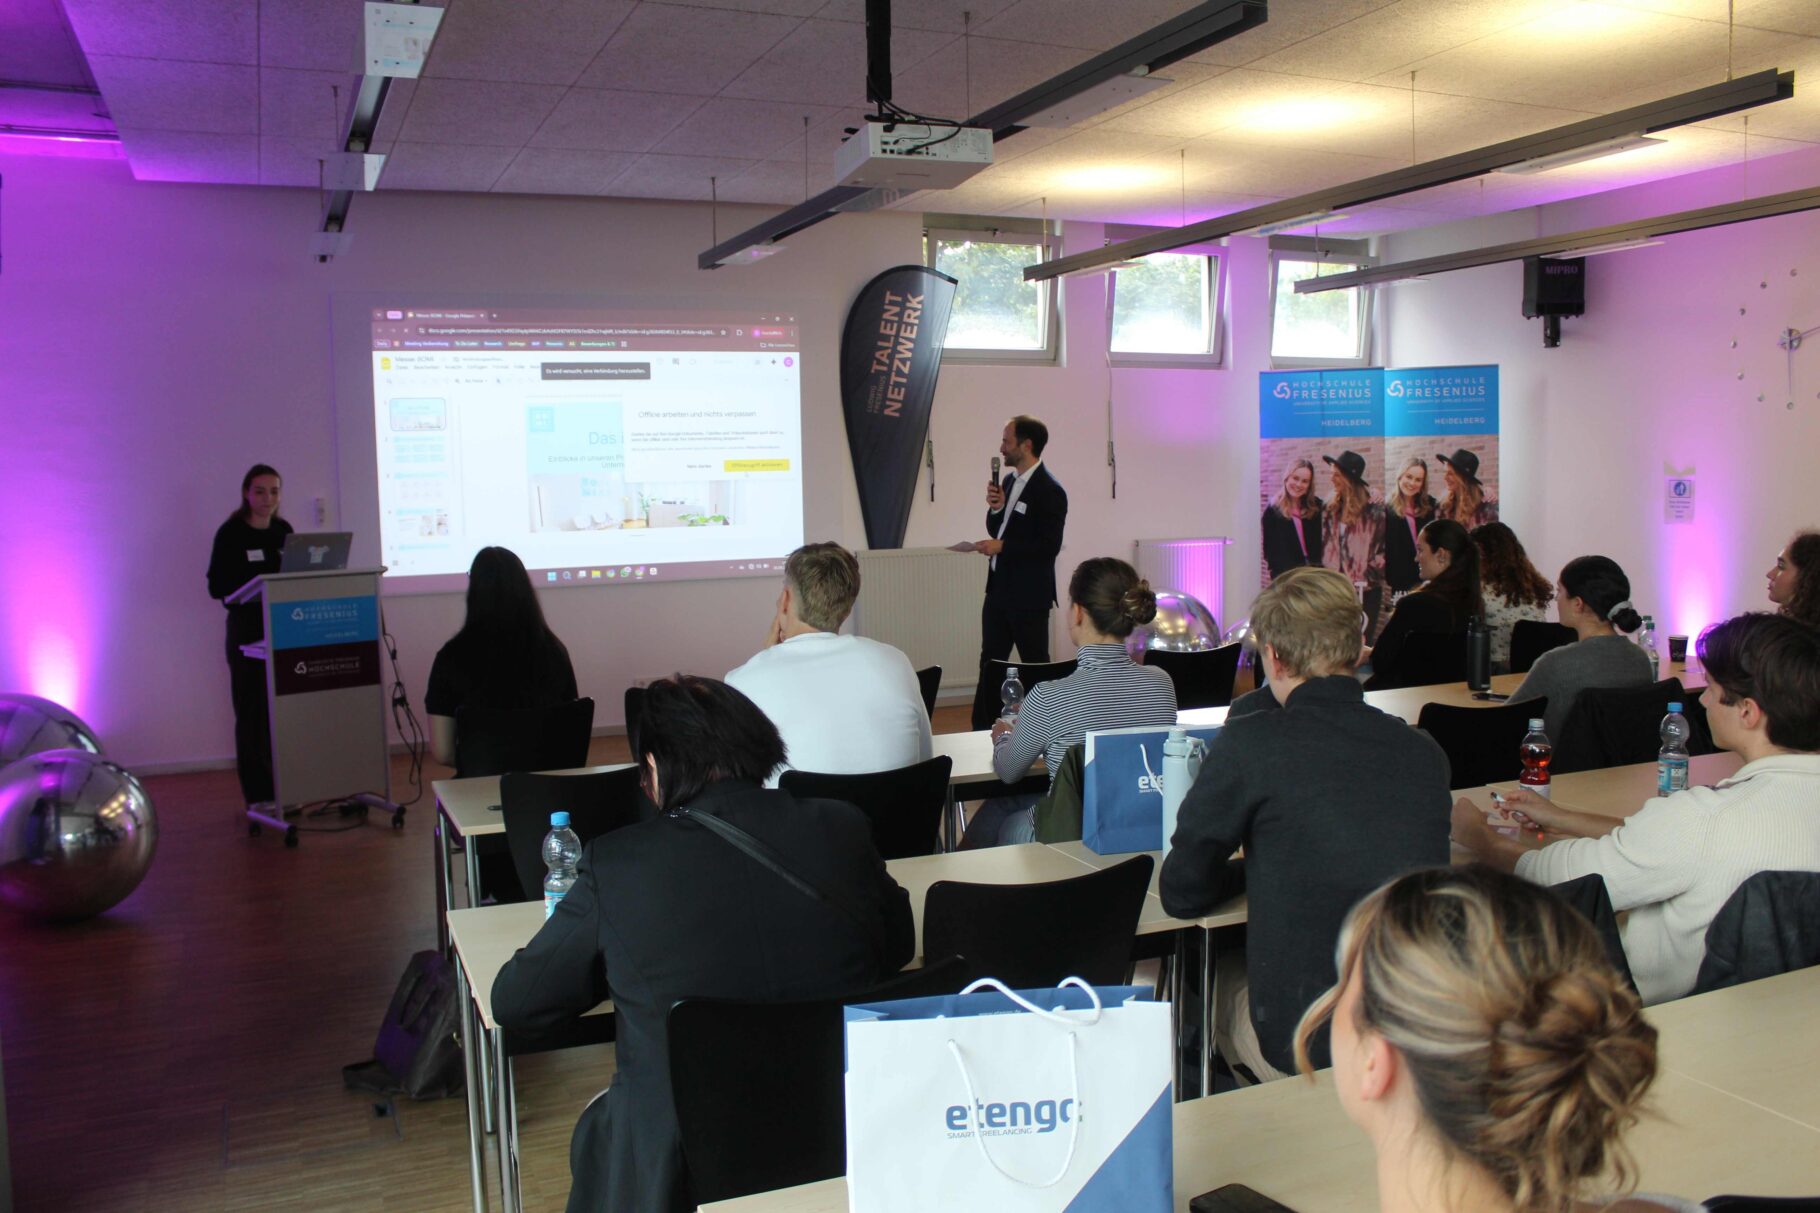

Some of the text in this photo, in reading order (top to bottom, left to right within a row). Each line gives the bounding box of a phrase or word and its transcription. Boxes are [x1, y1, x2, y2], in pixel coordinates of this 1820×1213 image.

[1545, 265, 1579, 274] MIPRO
[871, 291, 902, 373] TALENT
[883, 293, 925, 418] NETZWERK
[1292, 379, 1371, 388] HOCHSCHULE
[1406, 377, 1486, 386] HOCHSCHULE
[1292, 388, 1371, 399] FRESENIUS
[1407, 386, 1486, 397] FRESENIUS
[662, 410, 688, 418] arbeiten
[690, 410, 703, 418] und
[724, 410, 757, 419] verpassen
[1321, 418, 1371, 427] HEIDELBERG
[1434, 416, 1486, 425] HEIDELBERG
[588, 431, 617, 445] Das
[946, 1127, 1033, 1140] SMART REELANCING
